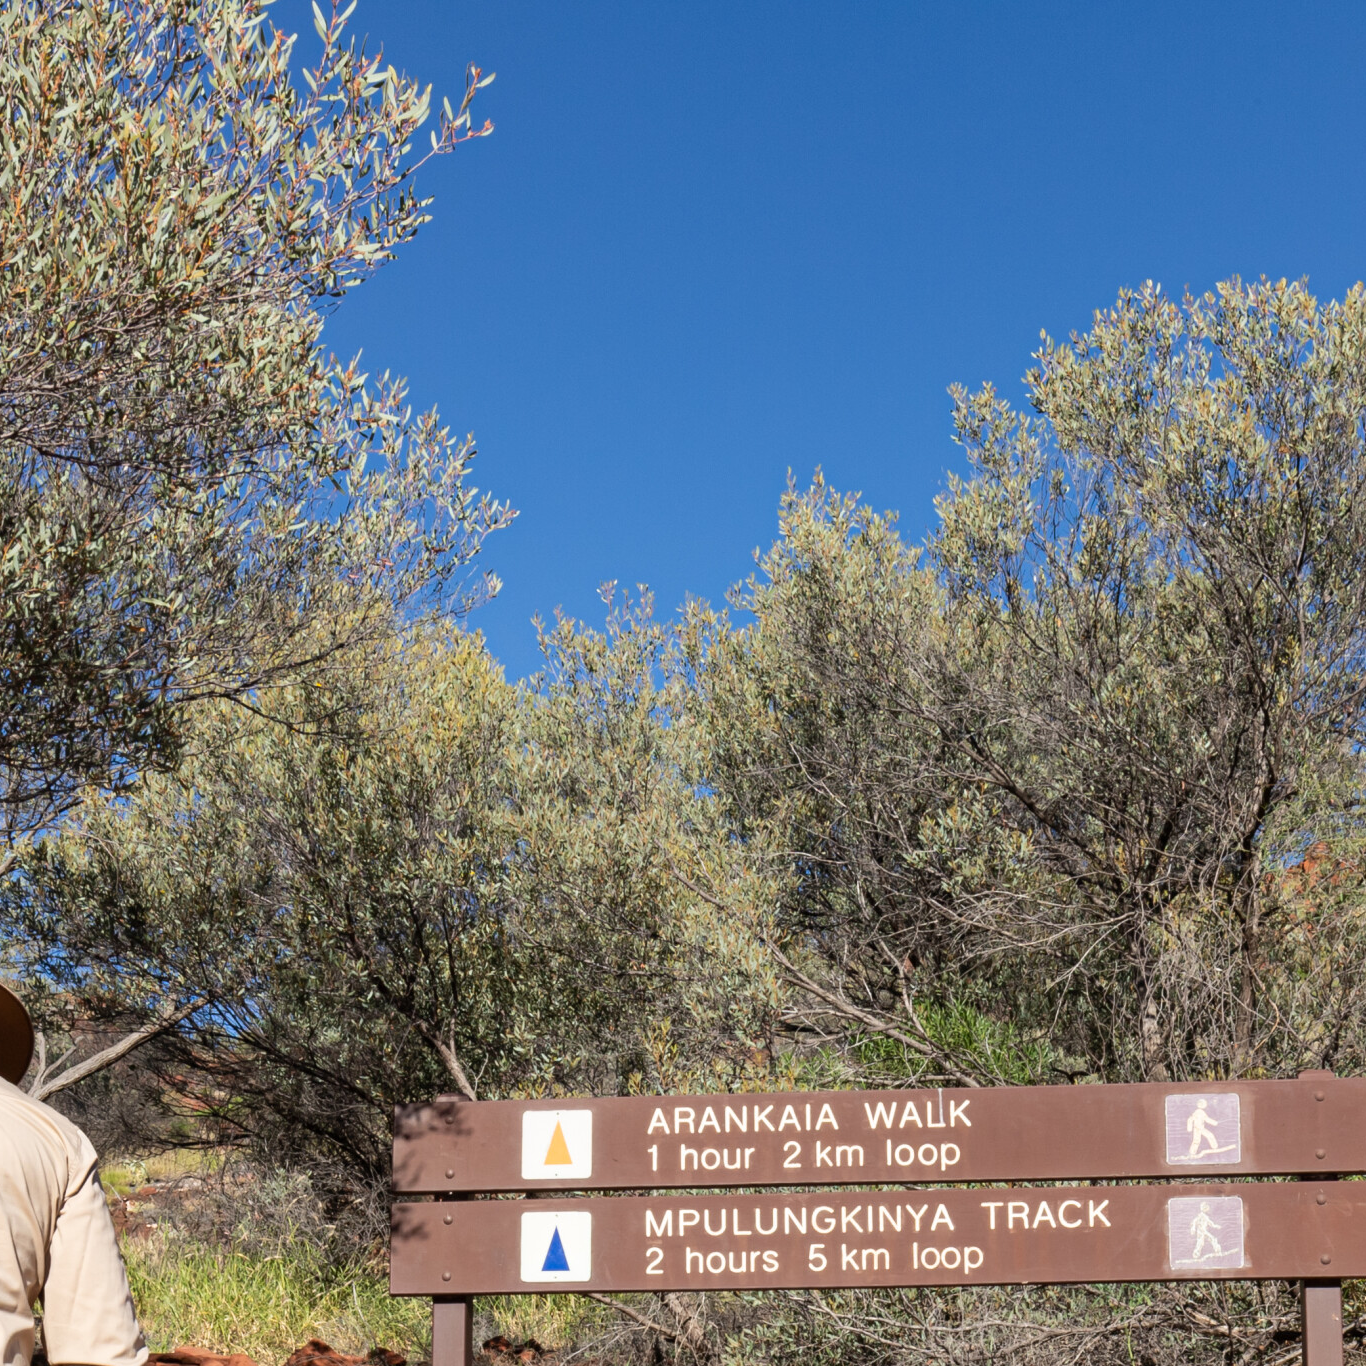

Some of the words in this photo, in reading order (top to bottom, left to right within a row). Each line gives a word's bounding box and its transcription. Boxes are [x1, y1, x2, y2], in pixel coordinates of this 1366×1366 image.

[647, 1103, 839, 1135] ARANKAIA
[863, 1099, 972, 1130] WALK
[647, 1144, 658, 1172] 1
[680, 1143, 756, 1171] hour
[886, 1138, 961, 1172] loop
[645, 1203, 955, 1238] MPULUNGKINYA
[980, 1199, 1112, 1230] TRACK
[645, 1246, 664, 1275] 2
[685, 1246, 780, 1274] hours
[912, 1241, 984, 1275] loop
